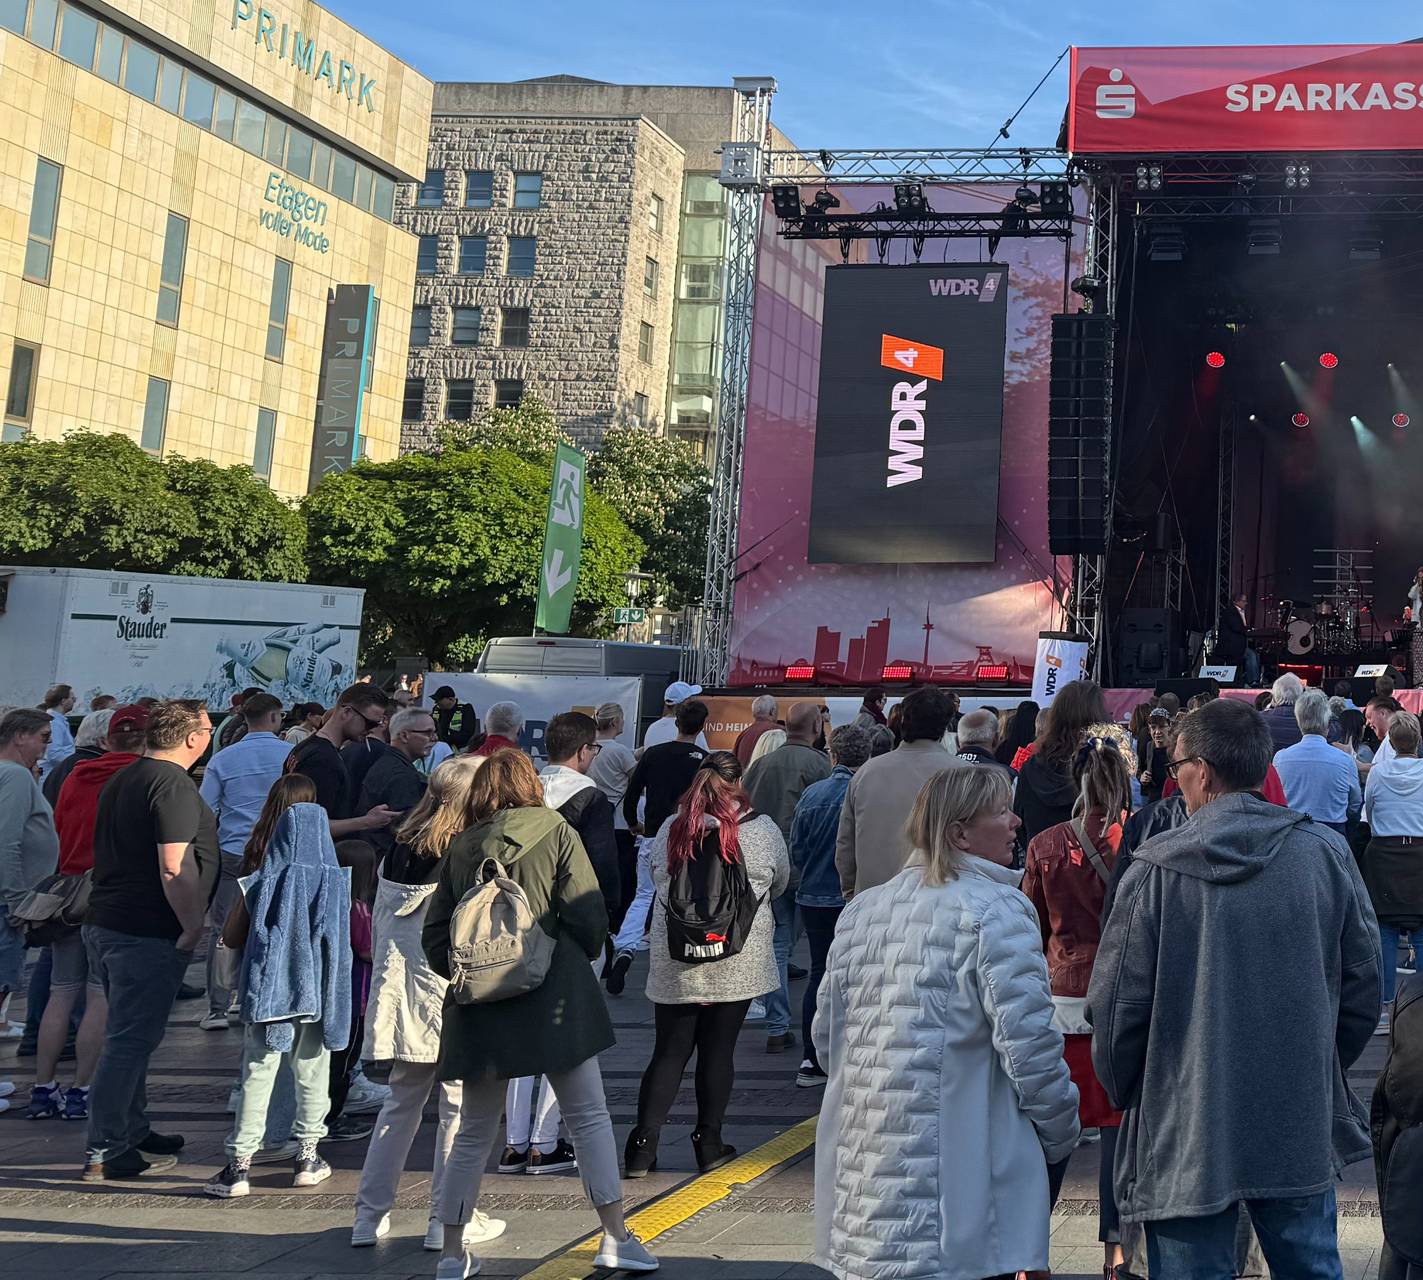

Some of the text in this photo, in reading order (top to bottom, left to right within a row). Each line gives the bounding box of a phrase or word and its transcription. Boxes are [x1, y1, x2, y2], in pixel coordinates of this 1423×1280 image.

[231, 0, 377, 113] PRIMARK
[264, 171, 328, 226] Etagen
[260, 208, 329, 254] voller Mode
[929, 279, 979, 296] WDR
[323, 318, 360, 473] PRIMARK
[887, 378, 928, 488] WDR
[116, 615, 168, 641] Stauder
[1045, 668, 1058, 697] WDR
[705, 722, 724, 732] IND
[684, 941, 724, 958] PUMA
